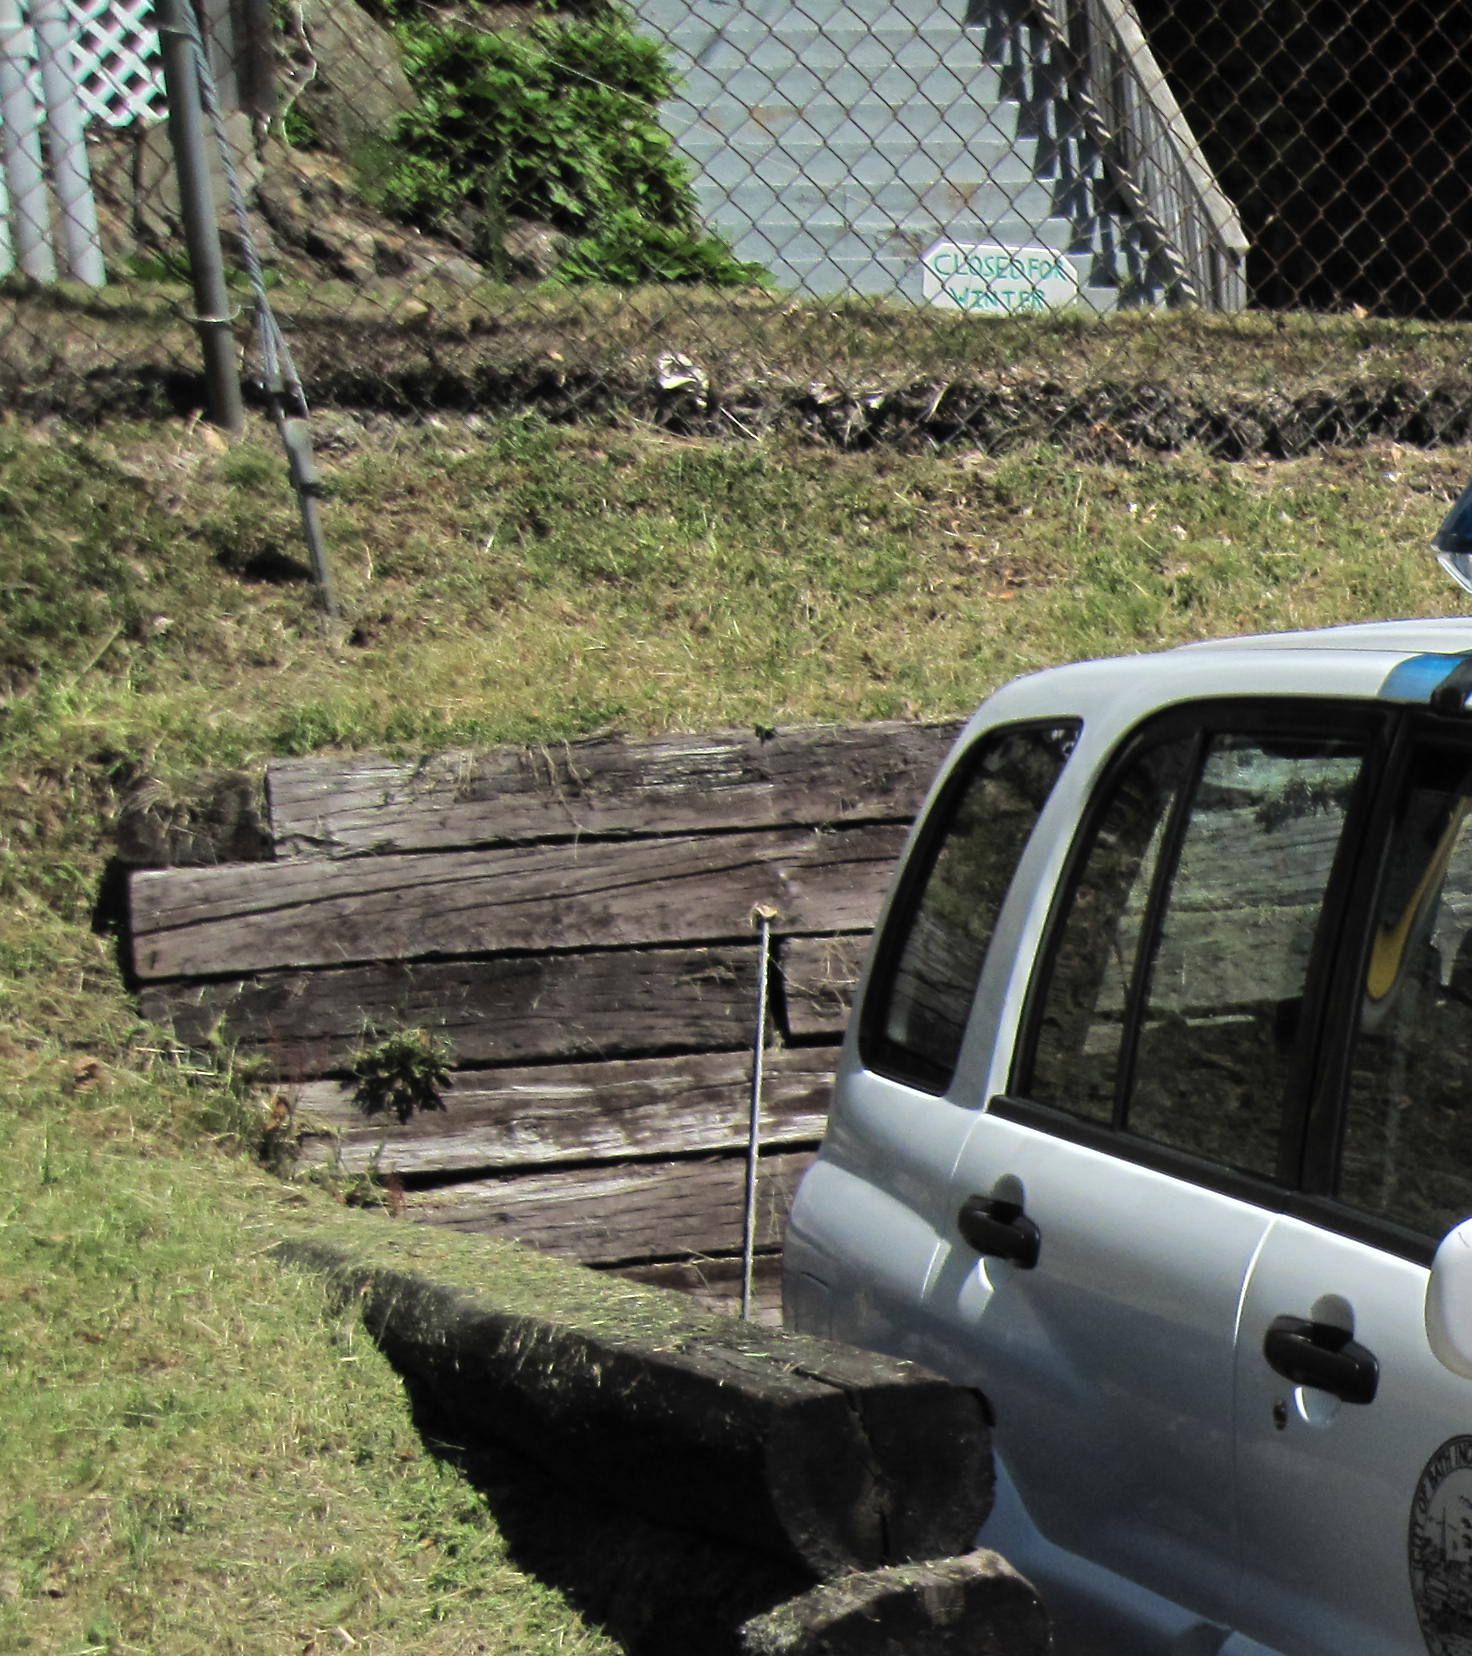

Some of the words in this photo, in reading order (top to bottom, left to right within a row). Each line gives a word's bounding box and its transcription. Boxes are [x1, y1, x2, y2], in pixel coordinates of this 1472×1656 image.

[933, 253, 1025, 281] CLOSED
[1027, 257, 1068, 282] FOR
[949, 286, 1047, 312] WINTER
